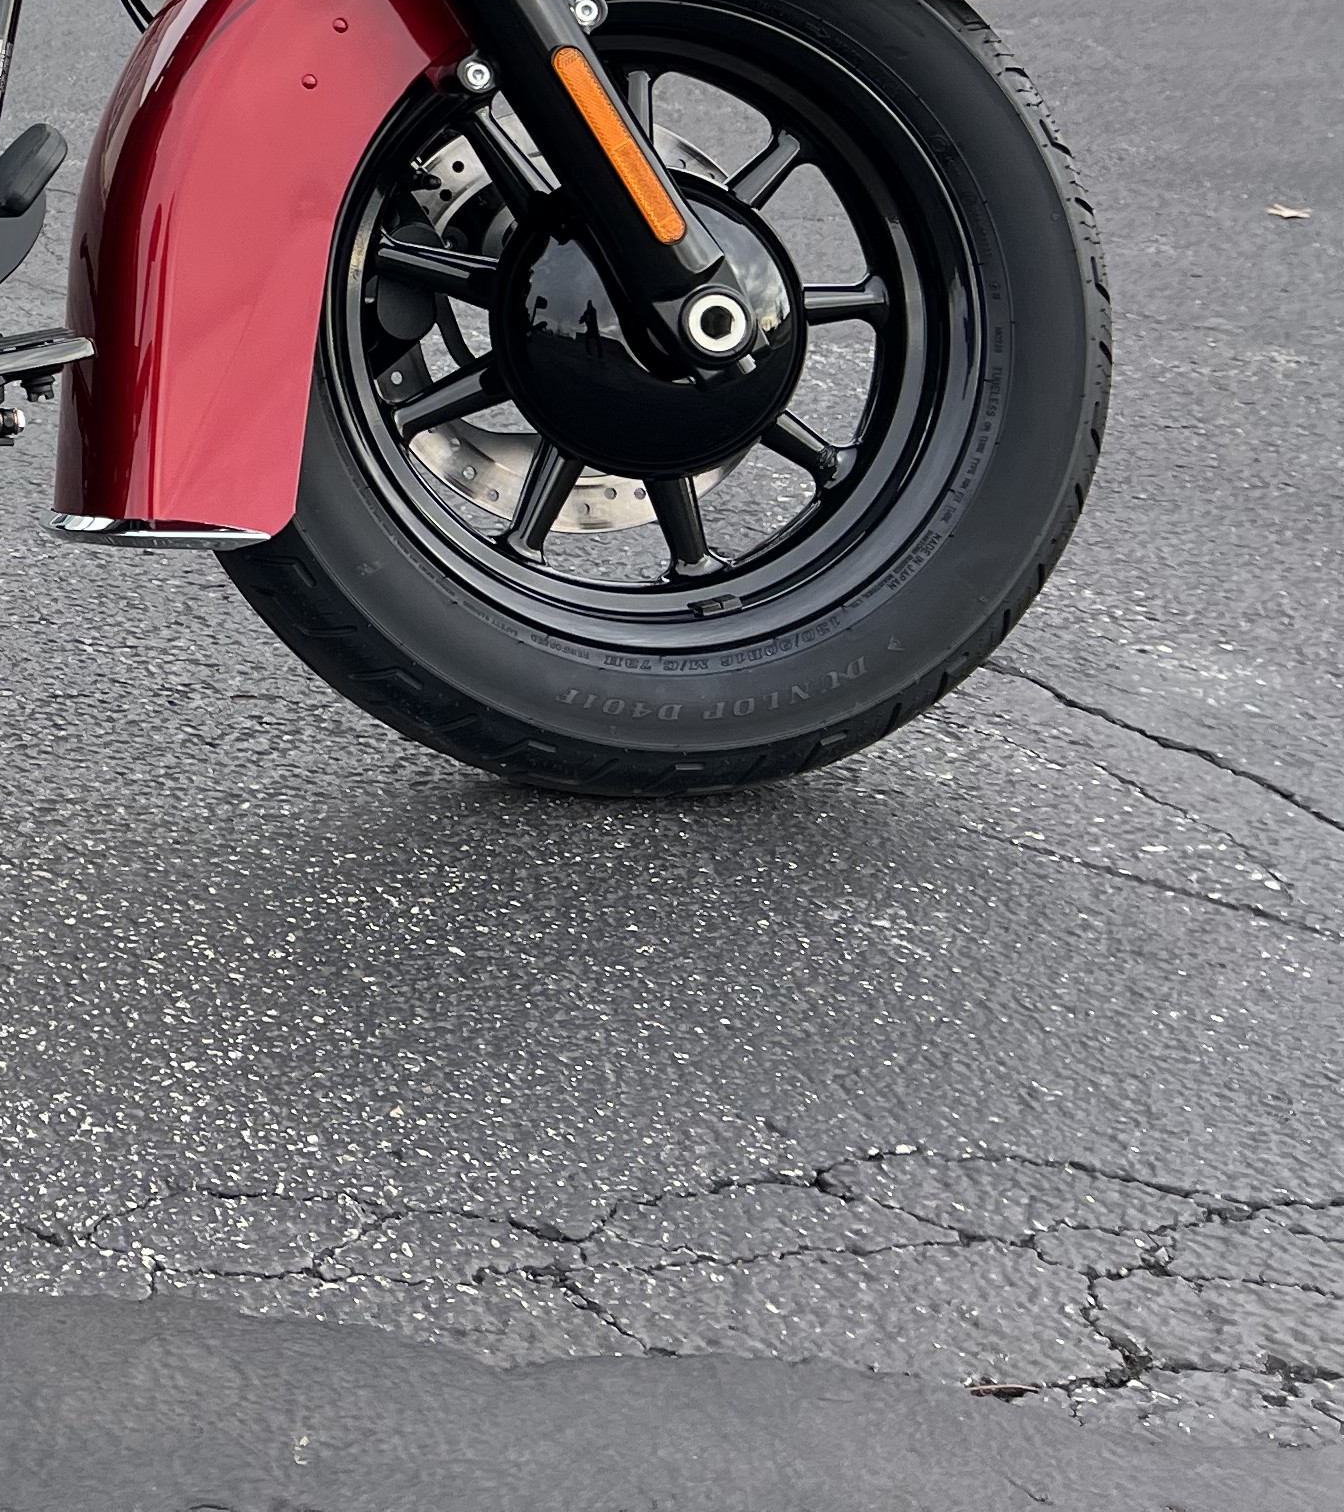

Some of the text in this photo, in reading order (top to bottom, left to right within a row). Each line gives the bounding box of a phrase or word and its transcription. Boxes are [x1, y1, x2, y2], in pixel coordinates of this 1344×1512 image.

[920, 531, 943, 556] MADE
[886, 562, 916, 591] JAPAN
[660, 656, 711, 671] M/C
[550, 653, 873, 723] DUNLOP D401F
